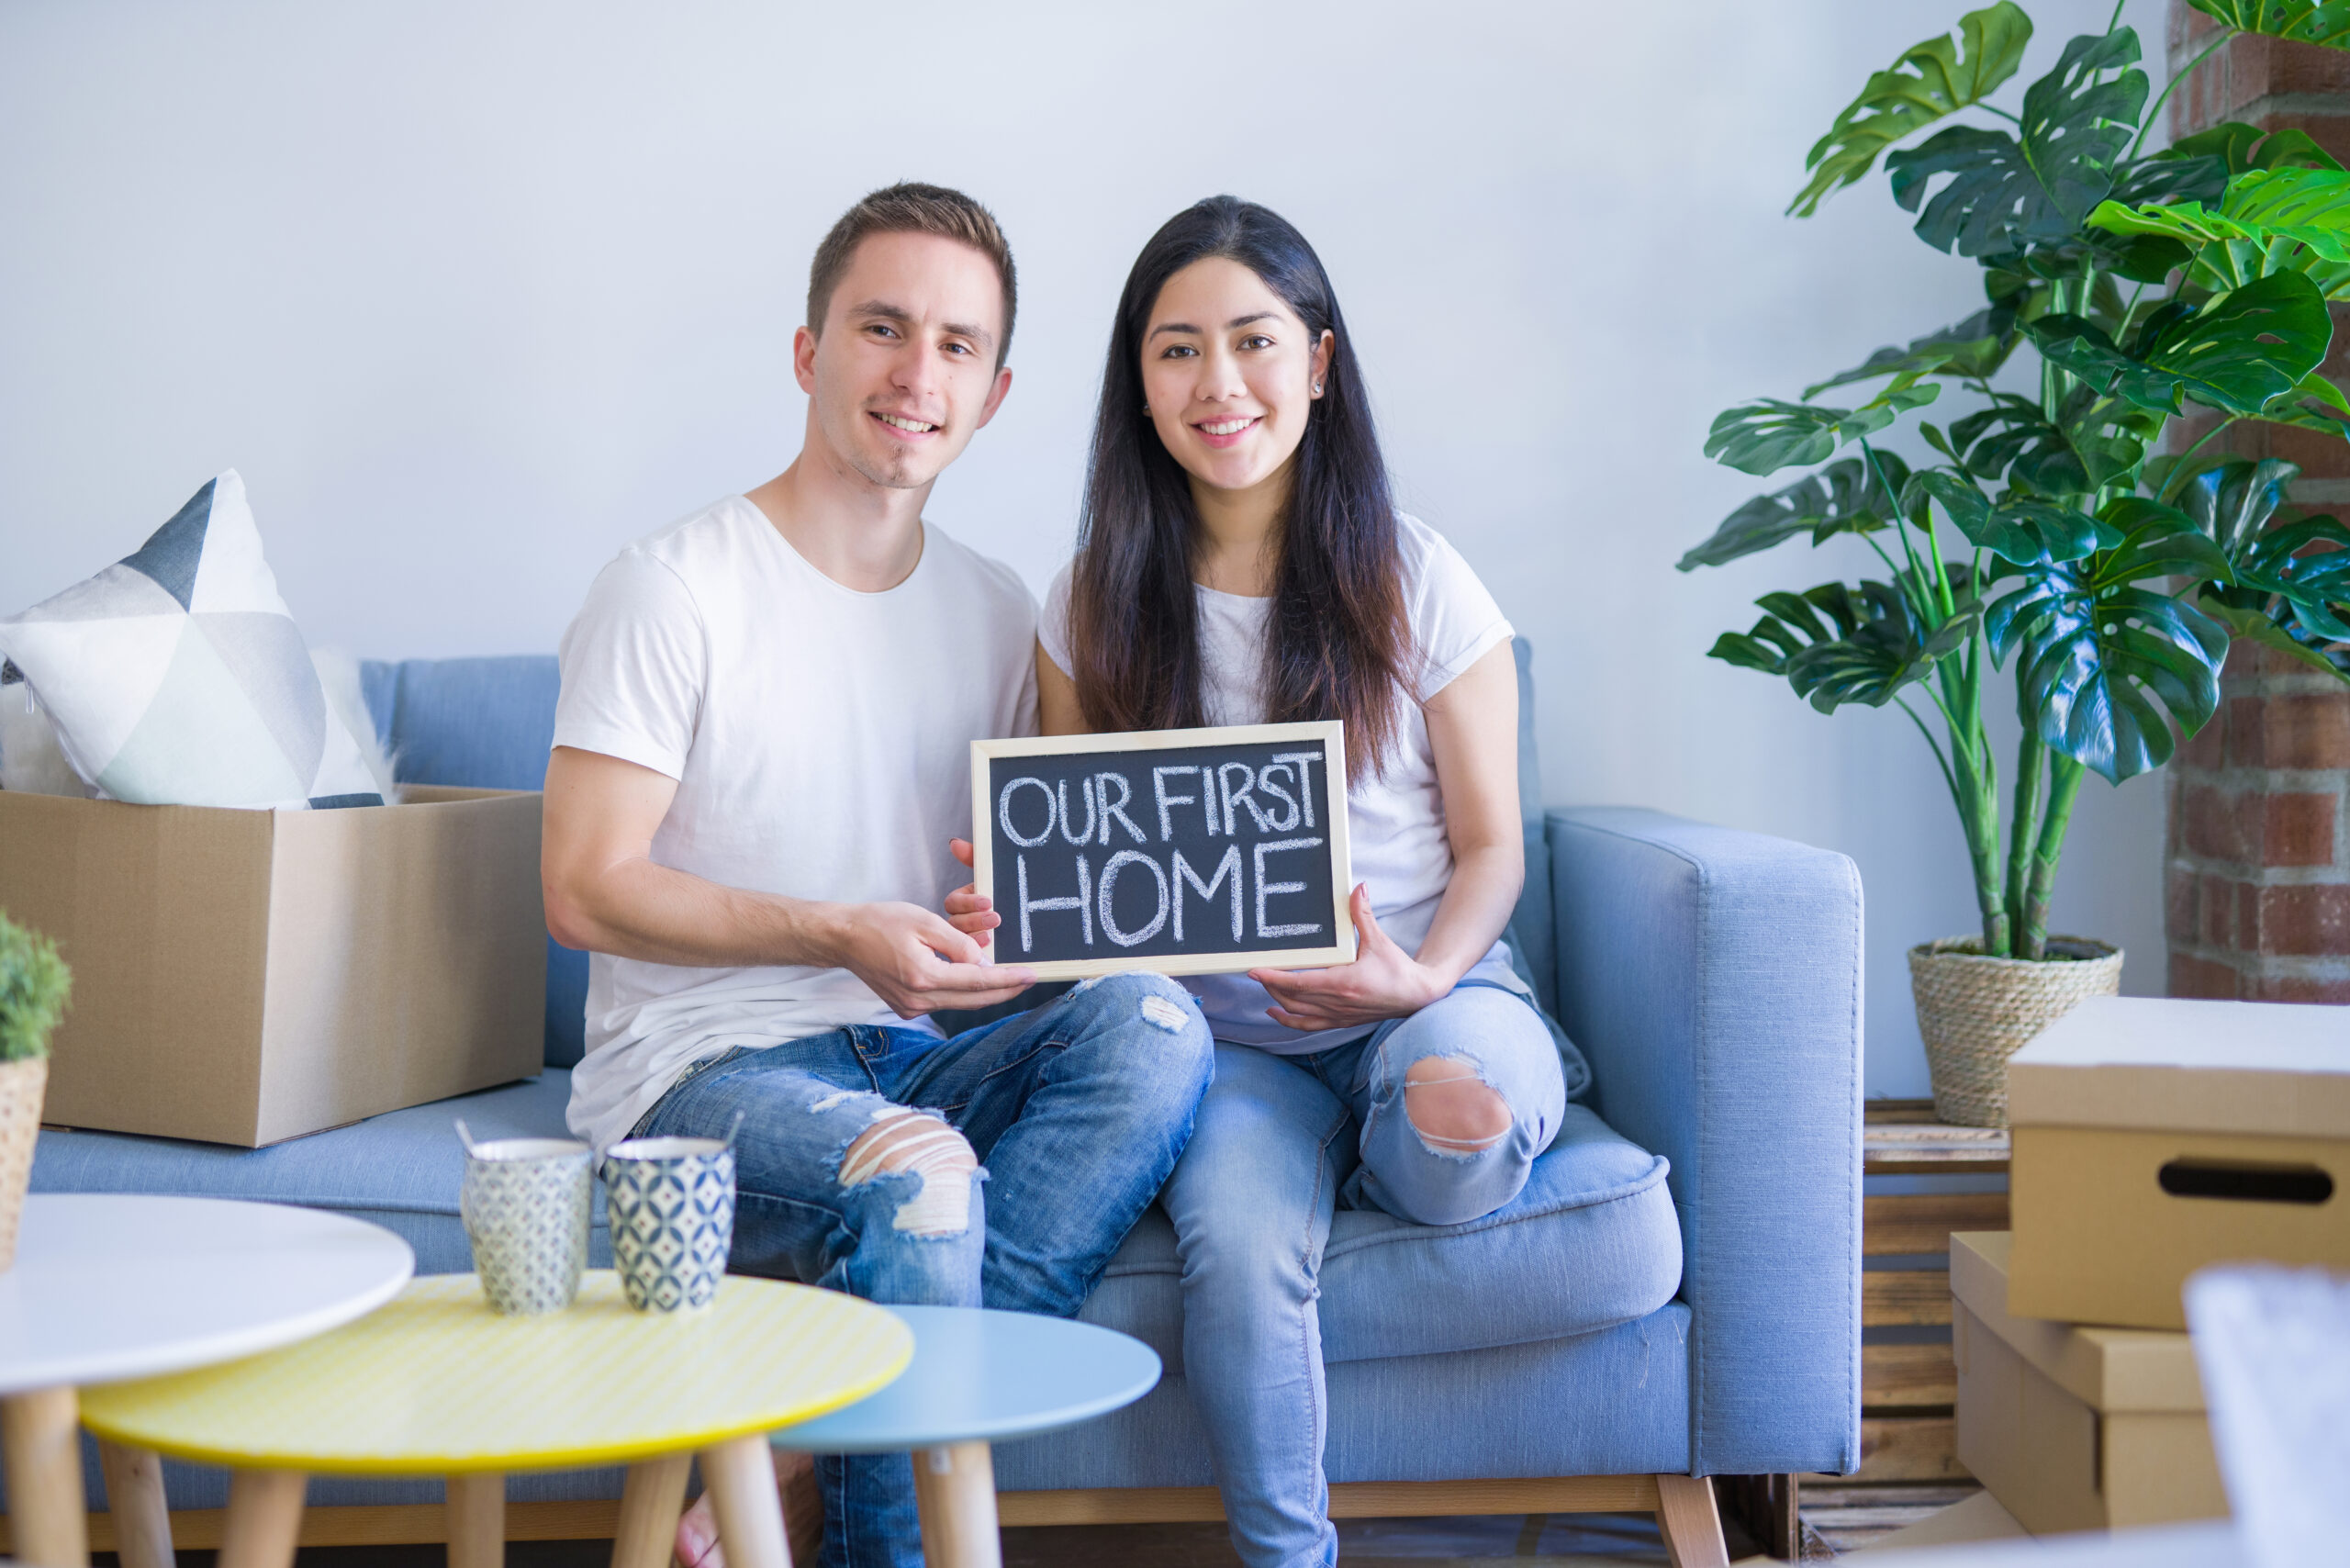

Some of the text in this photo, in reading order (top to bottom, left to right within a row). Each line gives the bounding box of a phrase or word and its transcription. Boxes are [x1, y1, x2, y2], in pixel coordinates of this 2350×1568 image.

[999, 751, 1324, 847] OUR FIRST
[1017, 837, 1324, 953] HOME
